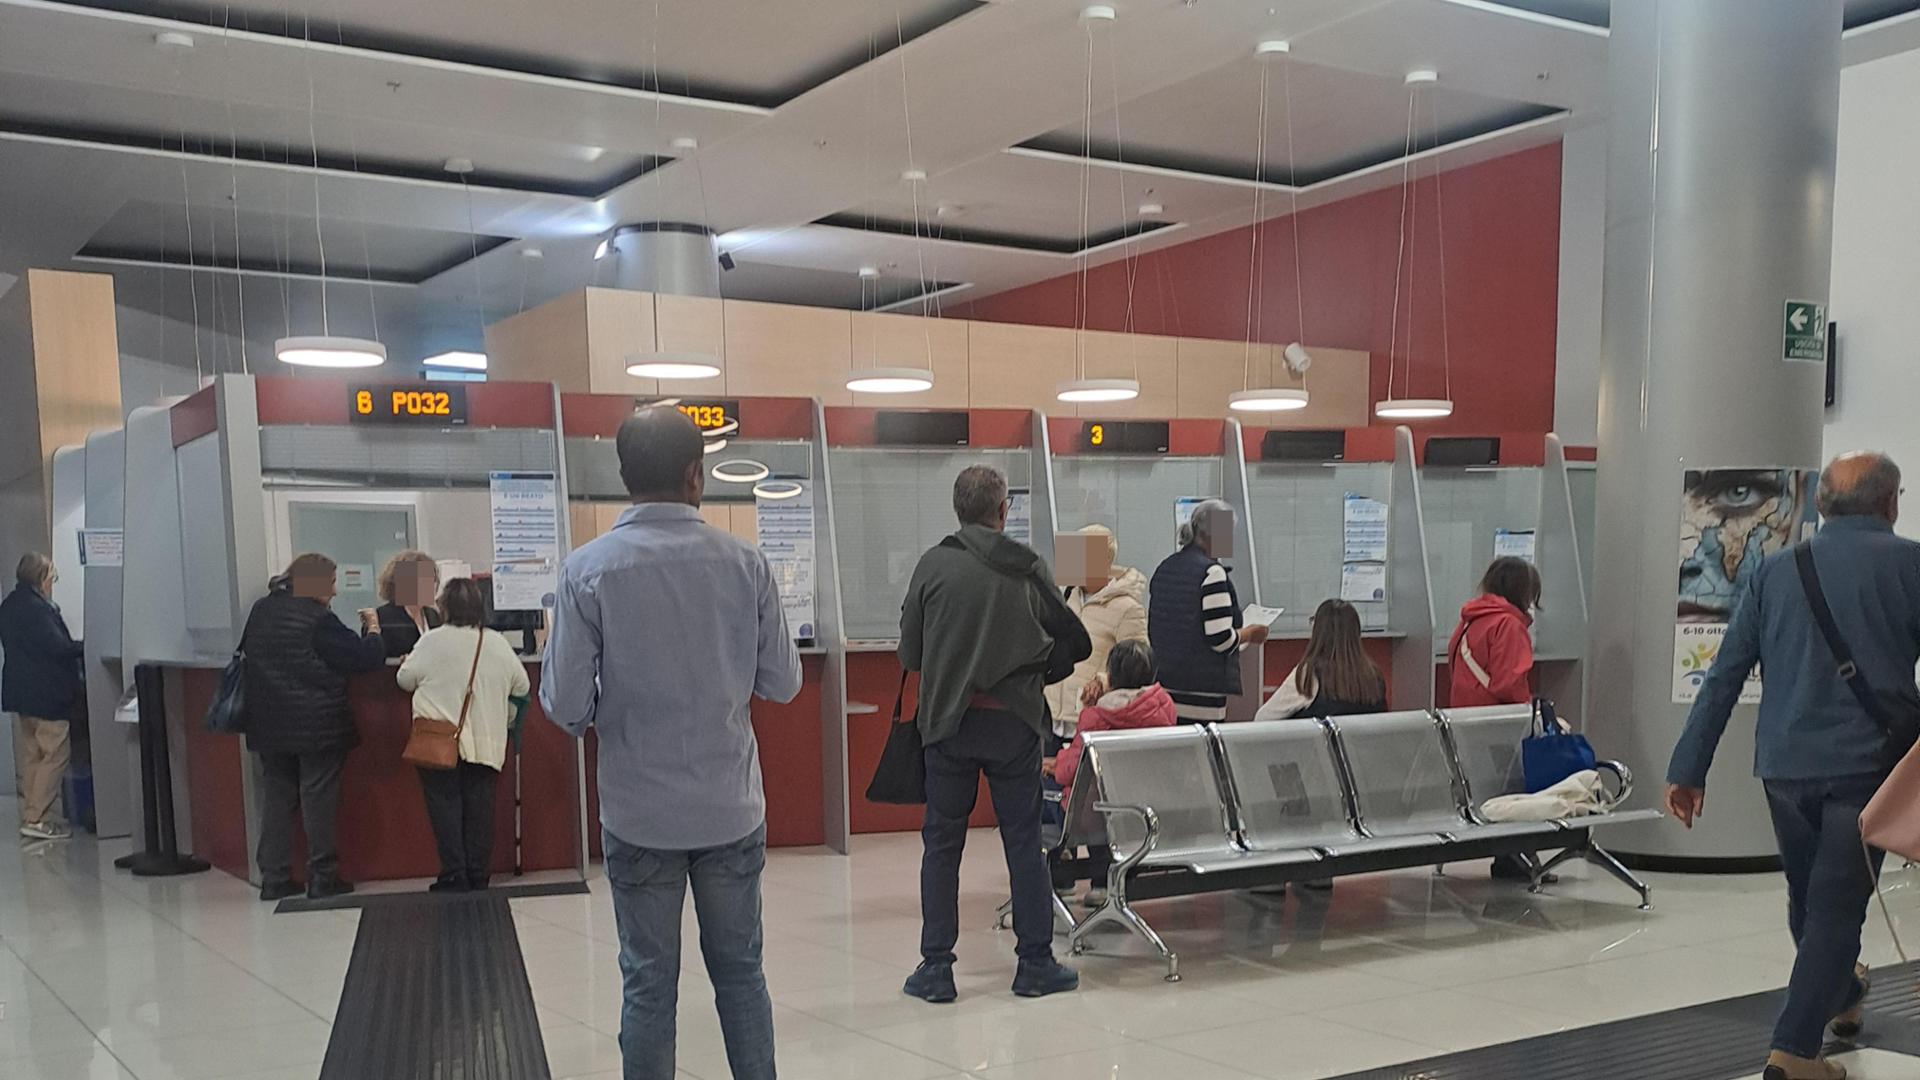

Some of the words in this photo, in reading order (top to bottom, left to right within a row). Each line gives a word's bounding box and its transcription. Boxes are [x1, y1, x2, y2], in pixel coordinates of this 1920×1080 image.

[392, 391, 450, 415] P032
[676, 405, 724, 427] 033
[1091, 425, 1103, 445] 3
[1683, 627, 1704, 636] 6-10
